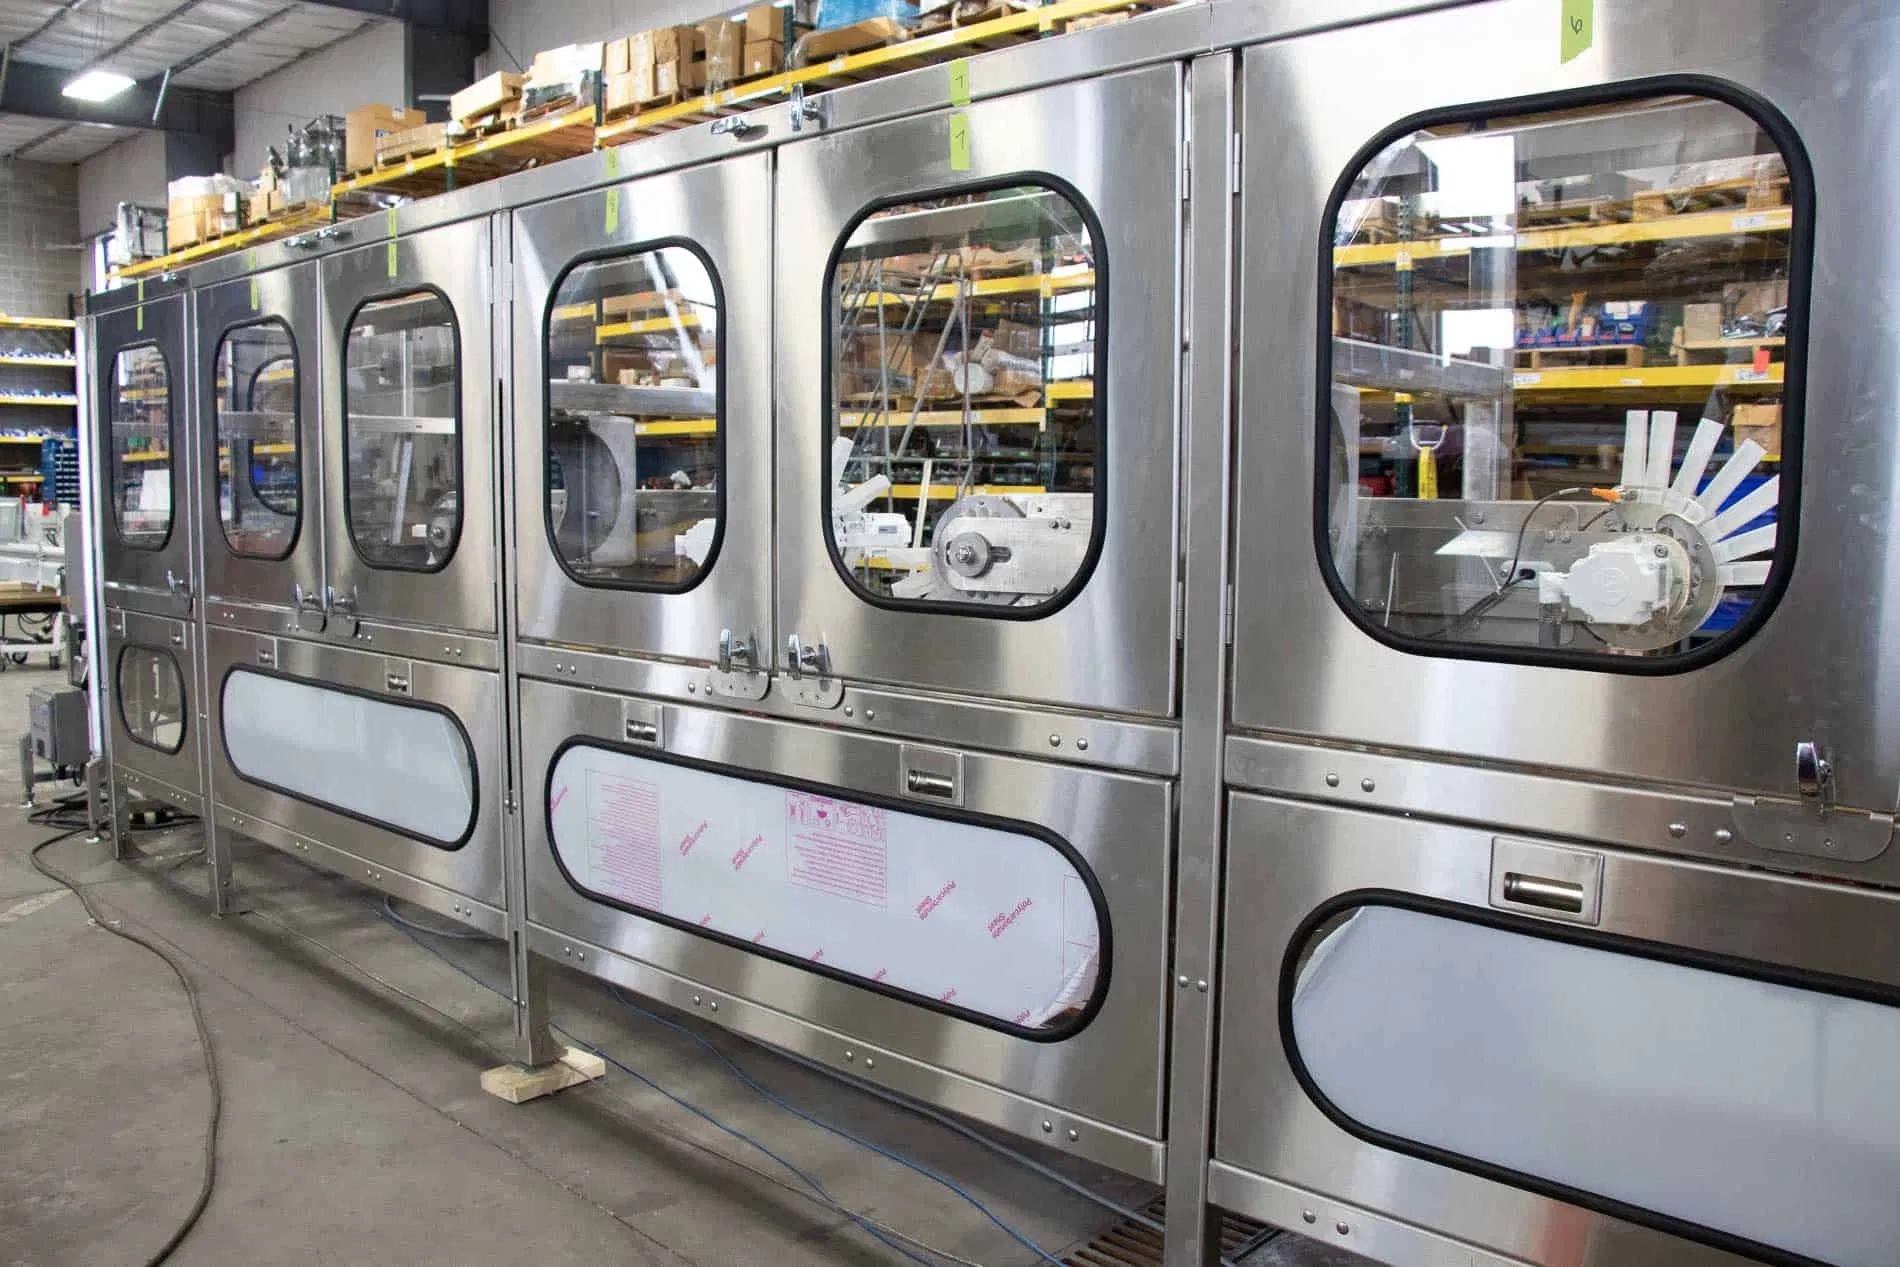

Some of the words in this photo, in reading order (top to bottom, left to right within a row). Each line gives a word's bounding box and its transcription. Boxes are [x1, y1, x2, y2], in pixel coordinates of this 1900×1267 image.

[1570, 15, 1583, 35] 6
[954, 75, 964, 88] 1
[955, 128, 965, 150] 1
